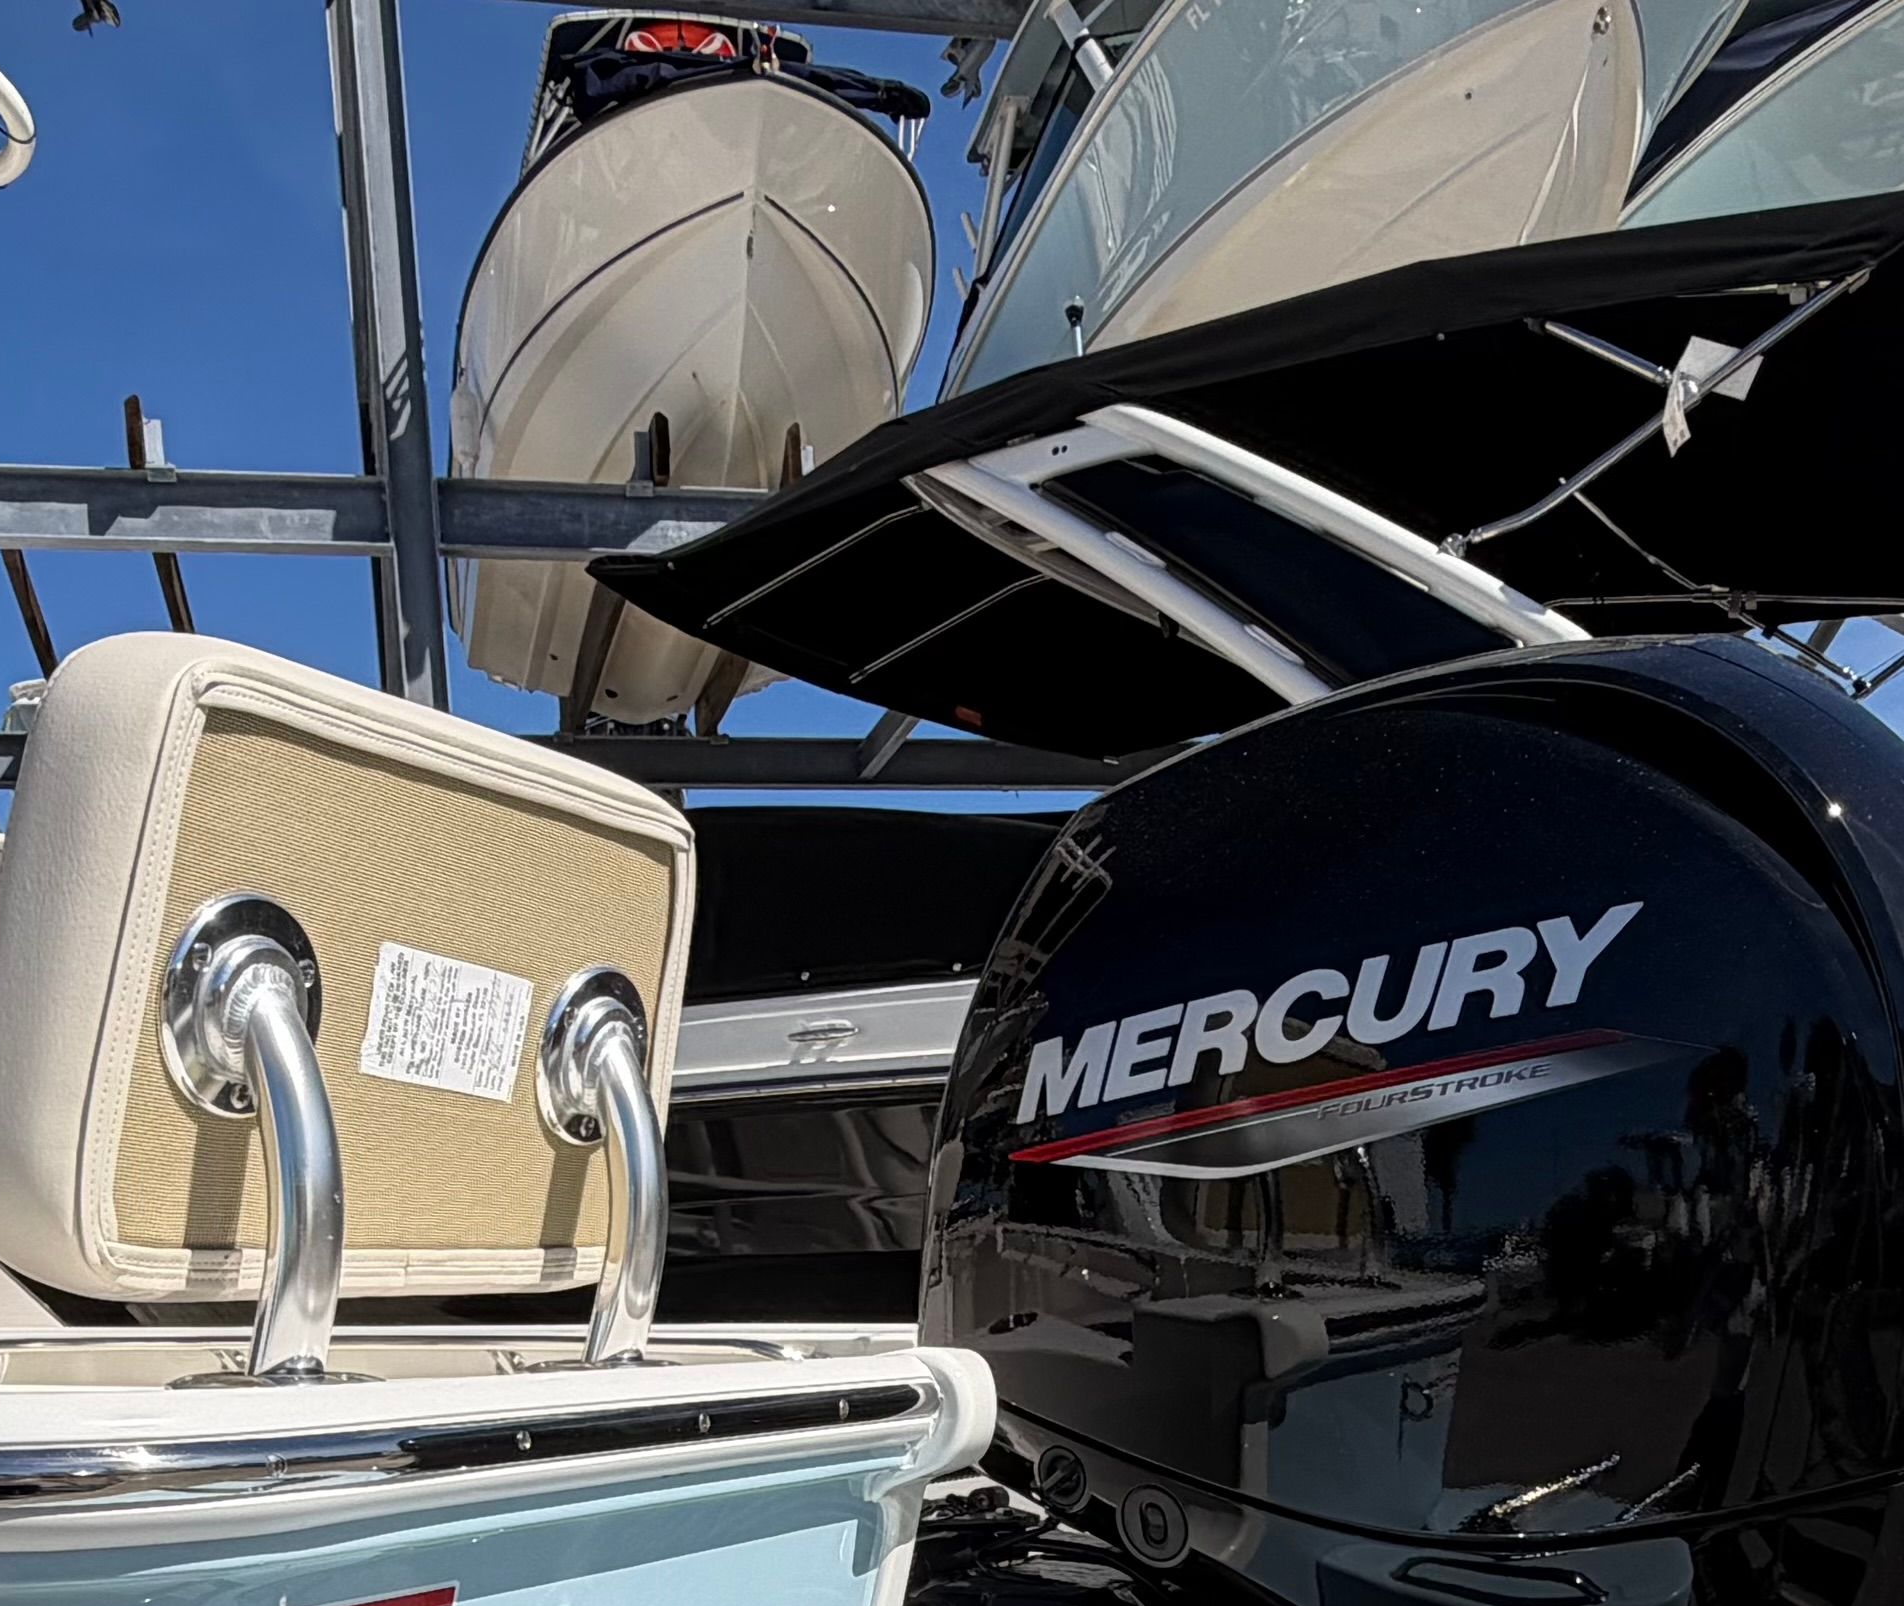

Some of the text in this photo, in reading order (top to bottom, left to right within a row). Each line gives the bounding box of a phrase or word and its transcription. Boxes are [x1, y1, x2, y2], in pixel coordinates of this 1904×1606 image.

[1184, 2, 1211, 31] FL
[1016, 901, 1644, 1125] MERCURY
[1317, 1061, 1553, 1121] FOURSTROKE
